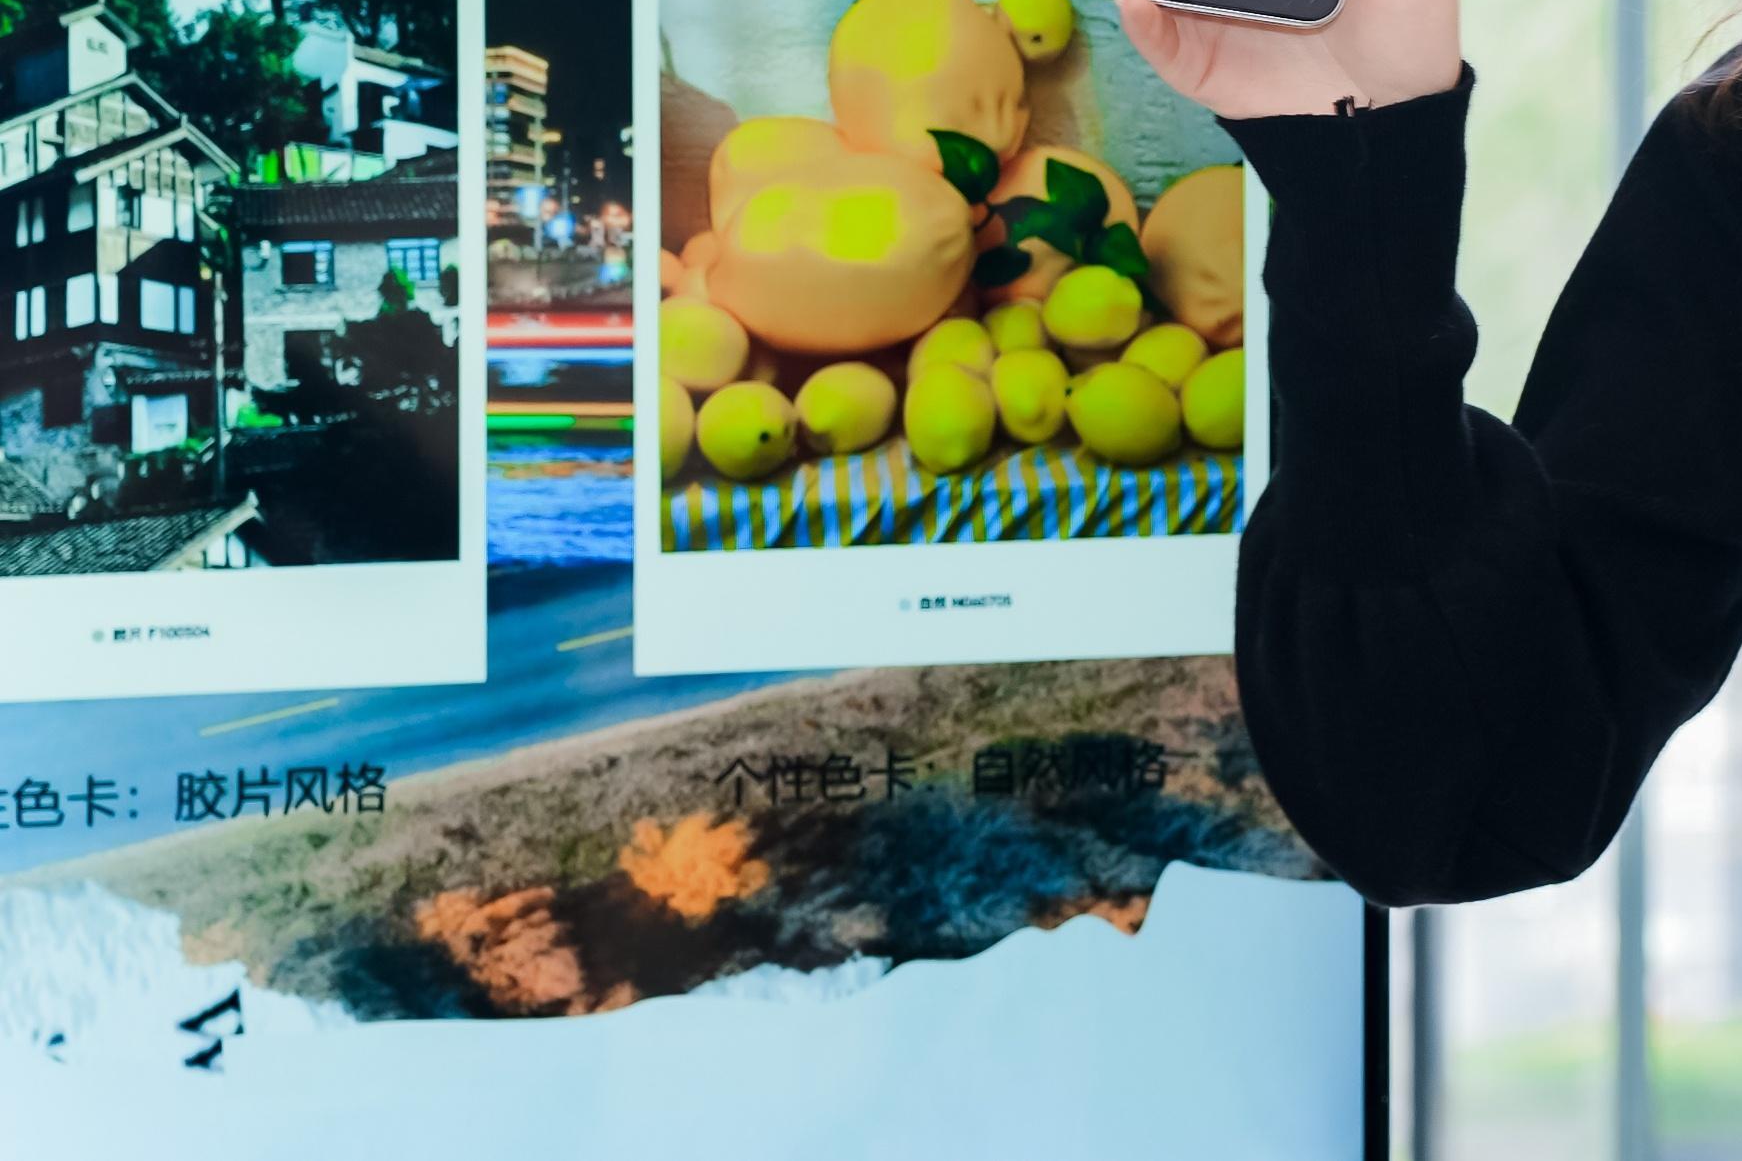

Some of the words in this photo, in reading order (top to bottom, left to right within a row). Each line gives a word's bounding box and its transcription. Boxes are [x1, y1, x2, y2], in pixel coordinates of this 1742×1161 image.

[0, 762, 386, 829] 色卡：胶片风格
